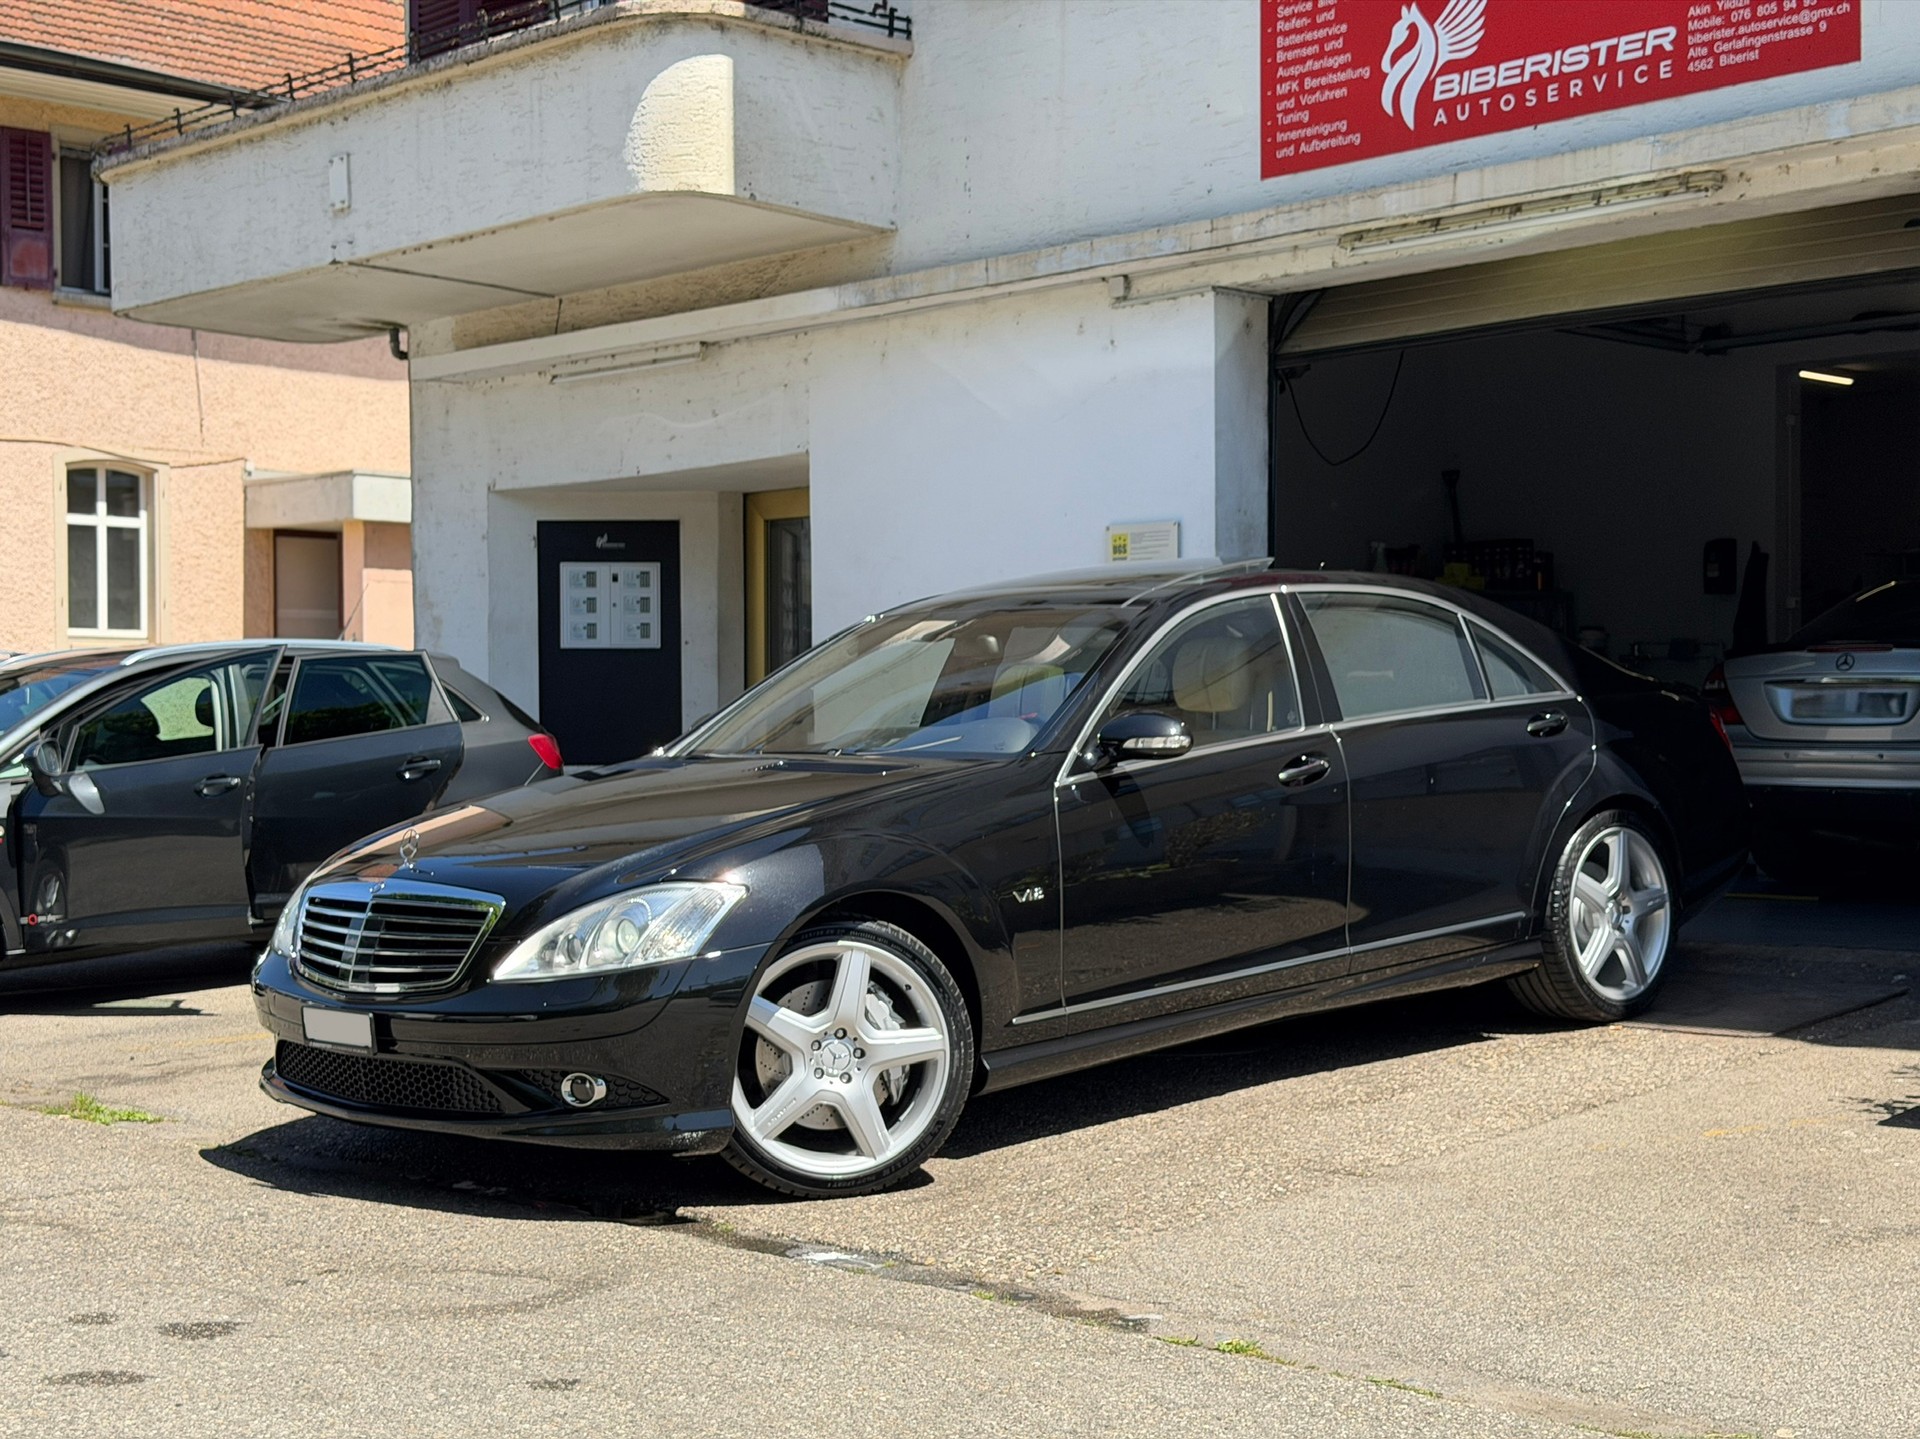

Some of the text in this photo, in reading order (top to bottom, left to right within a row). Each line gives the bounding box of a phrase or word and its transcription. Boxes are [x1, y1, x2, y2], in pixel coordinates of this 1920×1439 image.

[1276, 7, 1336, 32] Reifen- und
[1277, 2, 1313, 18] Service
[1687, 4, 1711, 18] Akin
[1687, 15, 1725, 32] Mobile:
[1731, 8, 1751, 23] 076
[1757, 2, 1777, 17] 805
[1783, 0, 1797, 12] 94
[1276, 22, 1348, 49] Batterieservice
[1687, 2, 1850, 45] biberister.autoservice@gmx.ch
[1276, 36, 1344, 63] Bremsen und
[1687, 20, 1828, 59] Alte Gerlafingenstrasse 9
[1276, 52, 1352, 78] Auspuffanlagen
[1433, 26, 1677, 101] BIBERISTER
[1687, 49, 1760, 73] 4562 Biberist
[1276, 66, 1371, 96] MFK Bereitstellung
[1433, 59, 1673, 127] AUTOSERVICE
[1276, 97, 1295, 111] und
[1276, 110, 1310, 126] Tuning
[1276, 119, 1348, 143] Innenreinigung
[1276, 133, 1361, 159] und Aufbereitung
